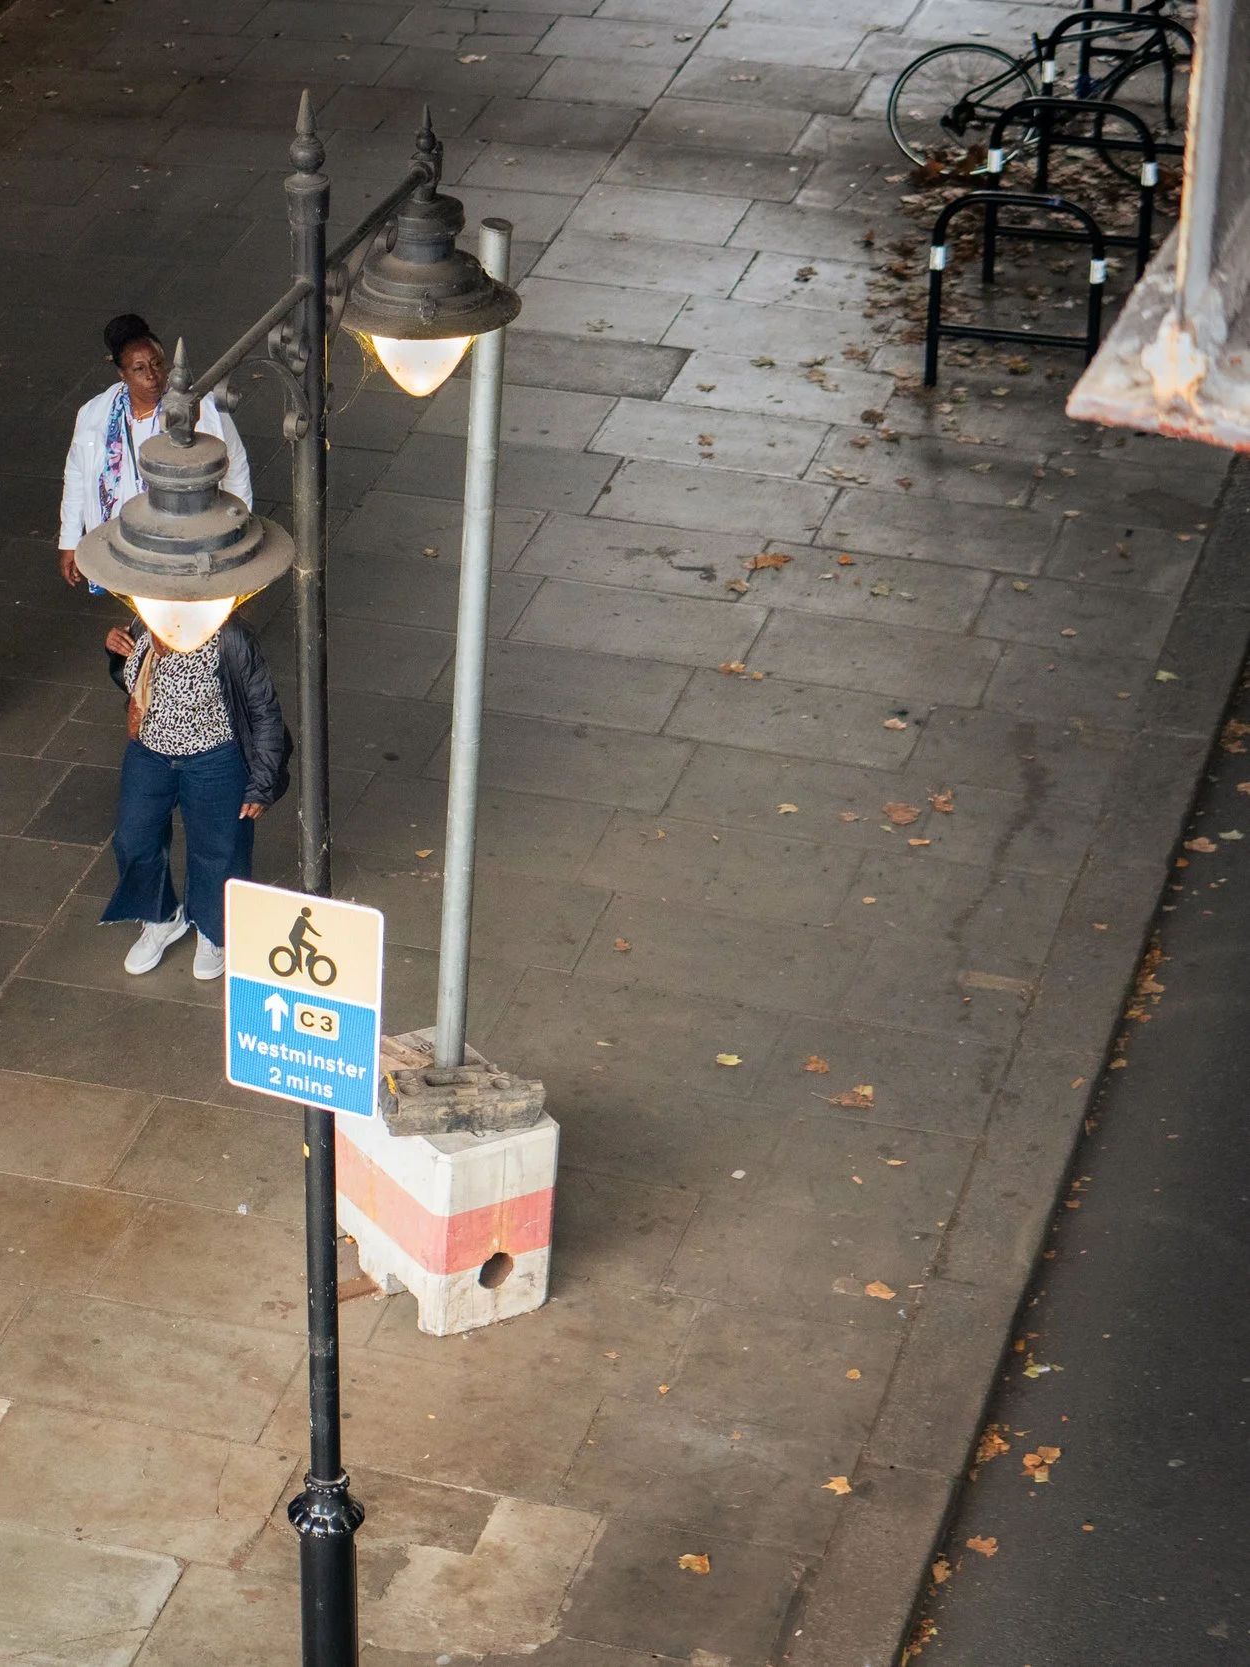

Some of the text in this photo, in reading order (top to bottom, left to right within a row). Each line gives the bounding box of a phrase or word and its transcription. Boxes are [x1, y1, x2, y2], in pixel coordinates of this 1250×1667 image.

[300, 1011, 333, 1032] C3
[237, 1031, 366, 1080] Westminster
[269, 1067, 333, 1098] 2 mins
